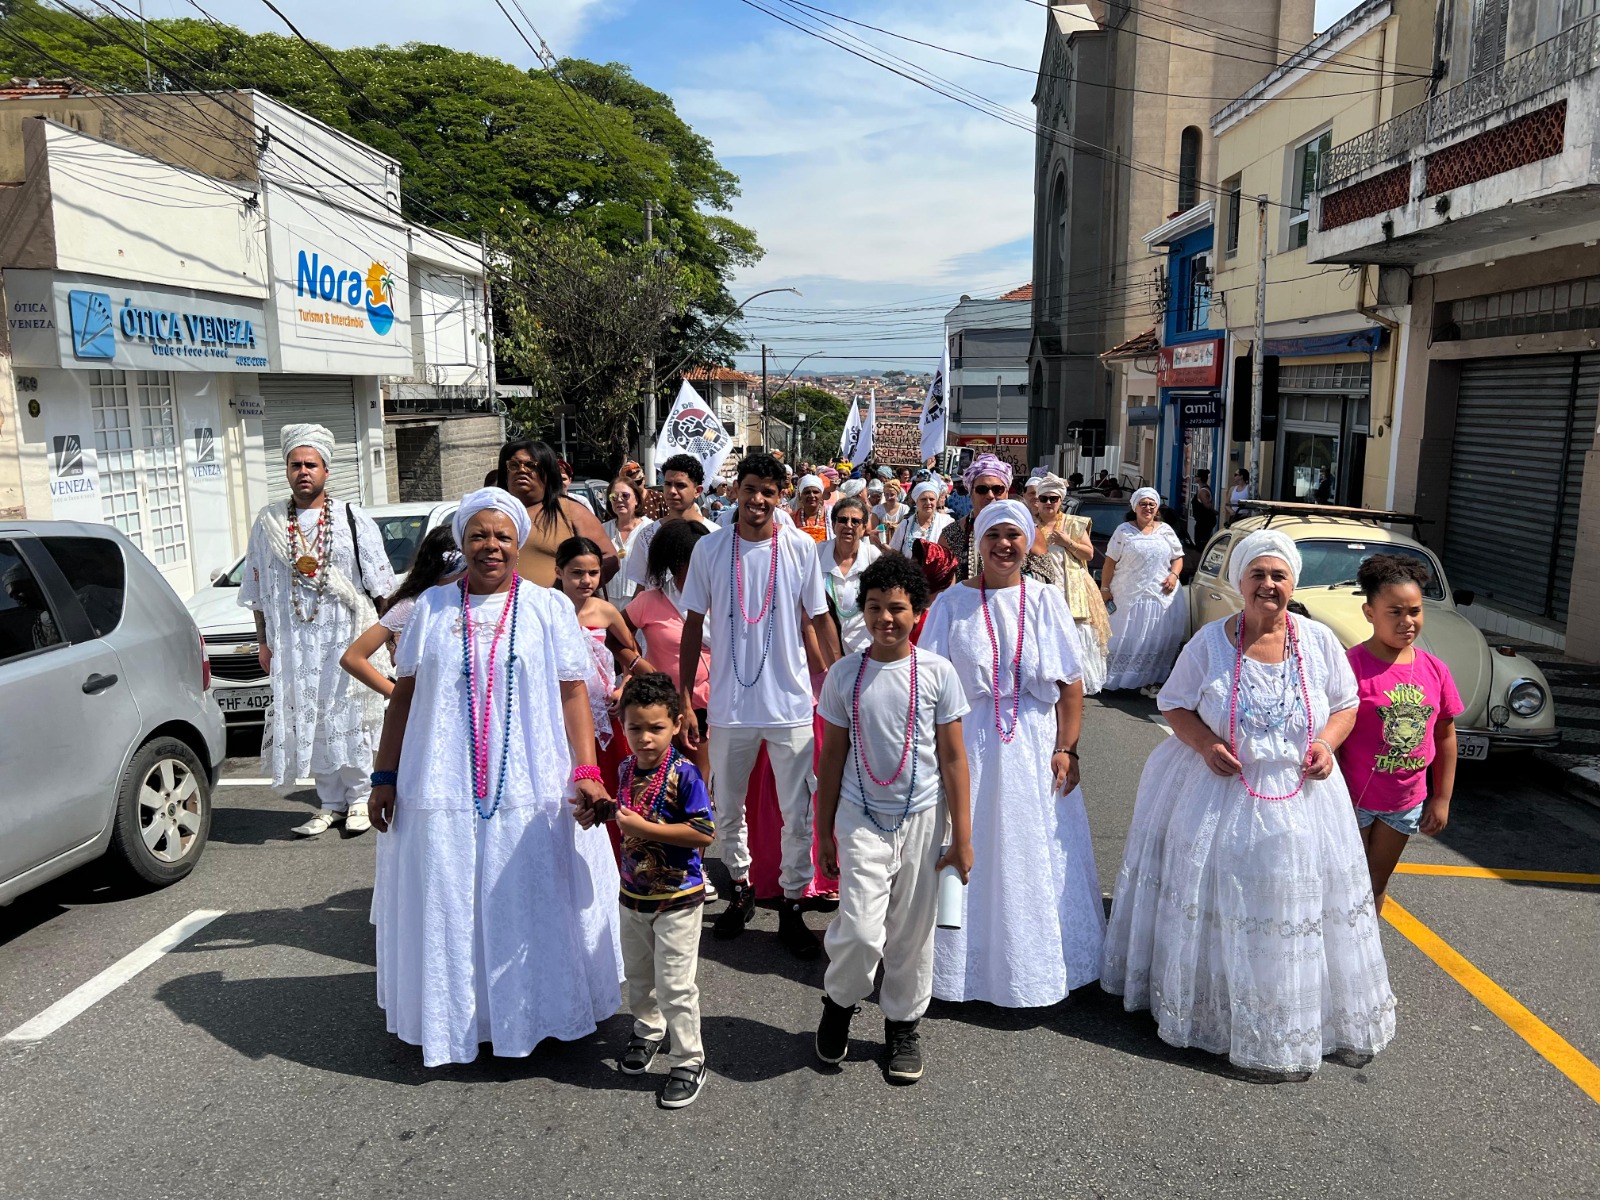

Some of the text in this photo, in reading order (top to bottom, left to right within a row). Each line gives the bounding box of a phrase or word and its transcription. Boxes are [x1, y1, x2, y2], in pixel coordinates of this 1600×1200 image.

[297, 250, 362, 305] Nora
[14, 300, 48, 313] ÓTICA
[10, 319, 55, 329] VENEZA
[120, 298, 257, 347] ÓTICA VENEZA
[298, 309, 363, 328] Turismo & Intercâmbio
[240, 400, 260, 408] ÓTICA
[1184, 401, 1216, 414] amil
[238, 408, 264, 416] VENEZA
[192, 464, 222, 478] VENEZA
[49, 478, 94, 496] VENEZA
[1383, 687, 1426, 707] WILD
[1457, 744, 1484, 757] 397
[1374, 754, 1426, 774] THANG
